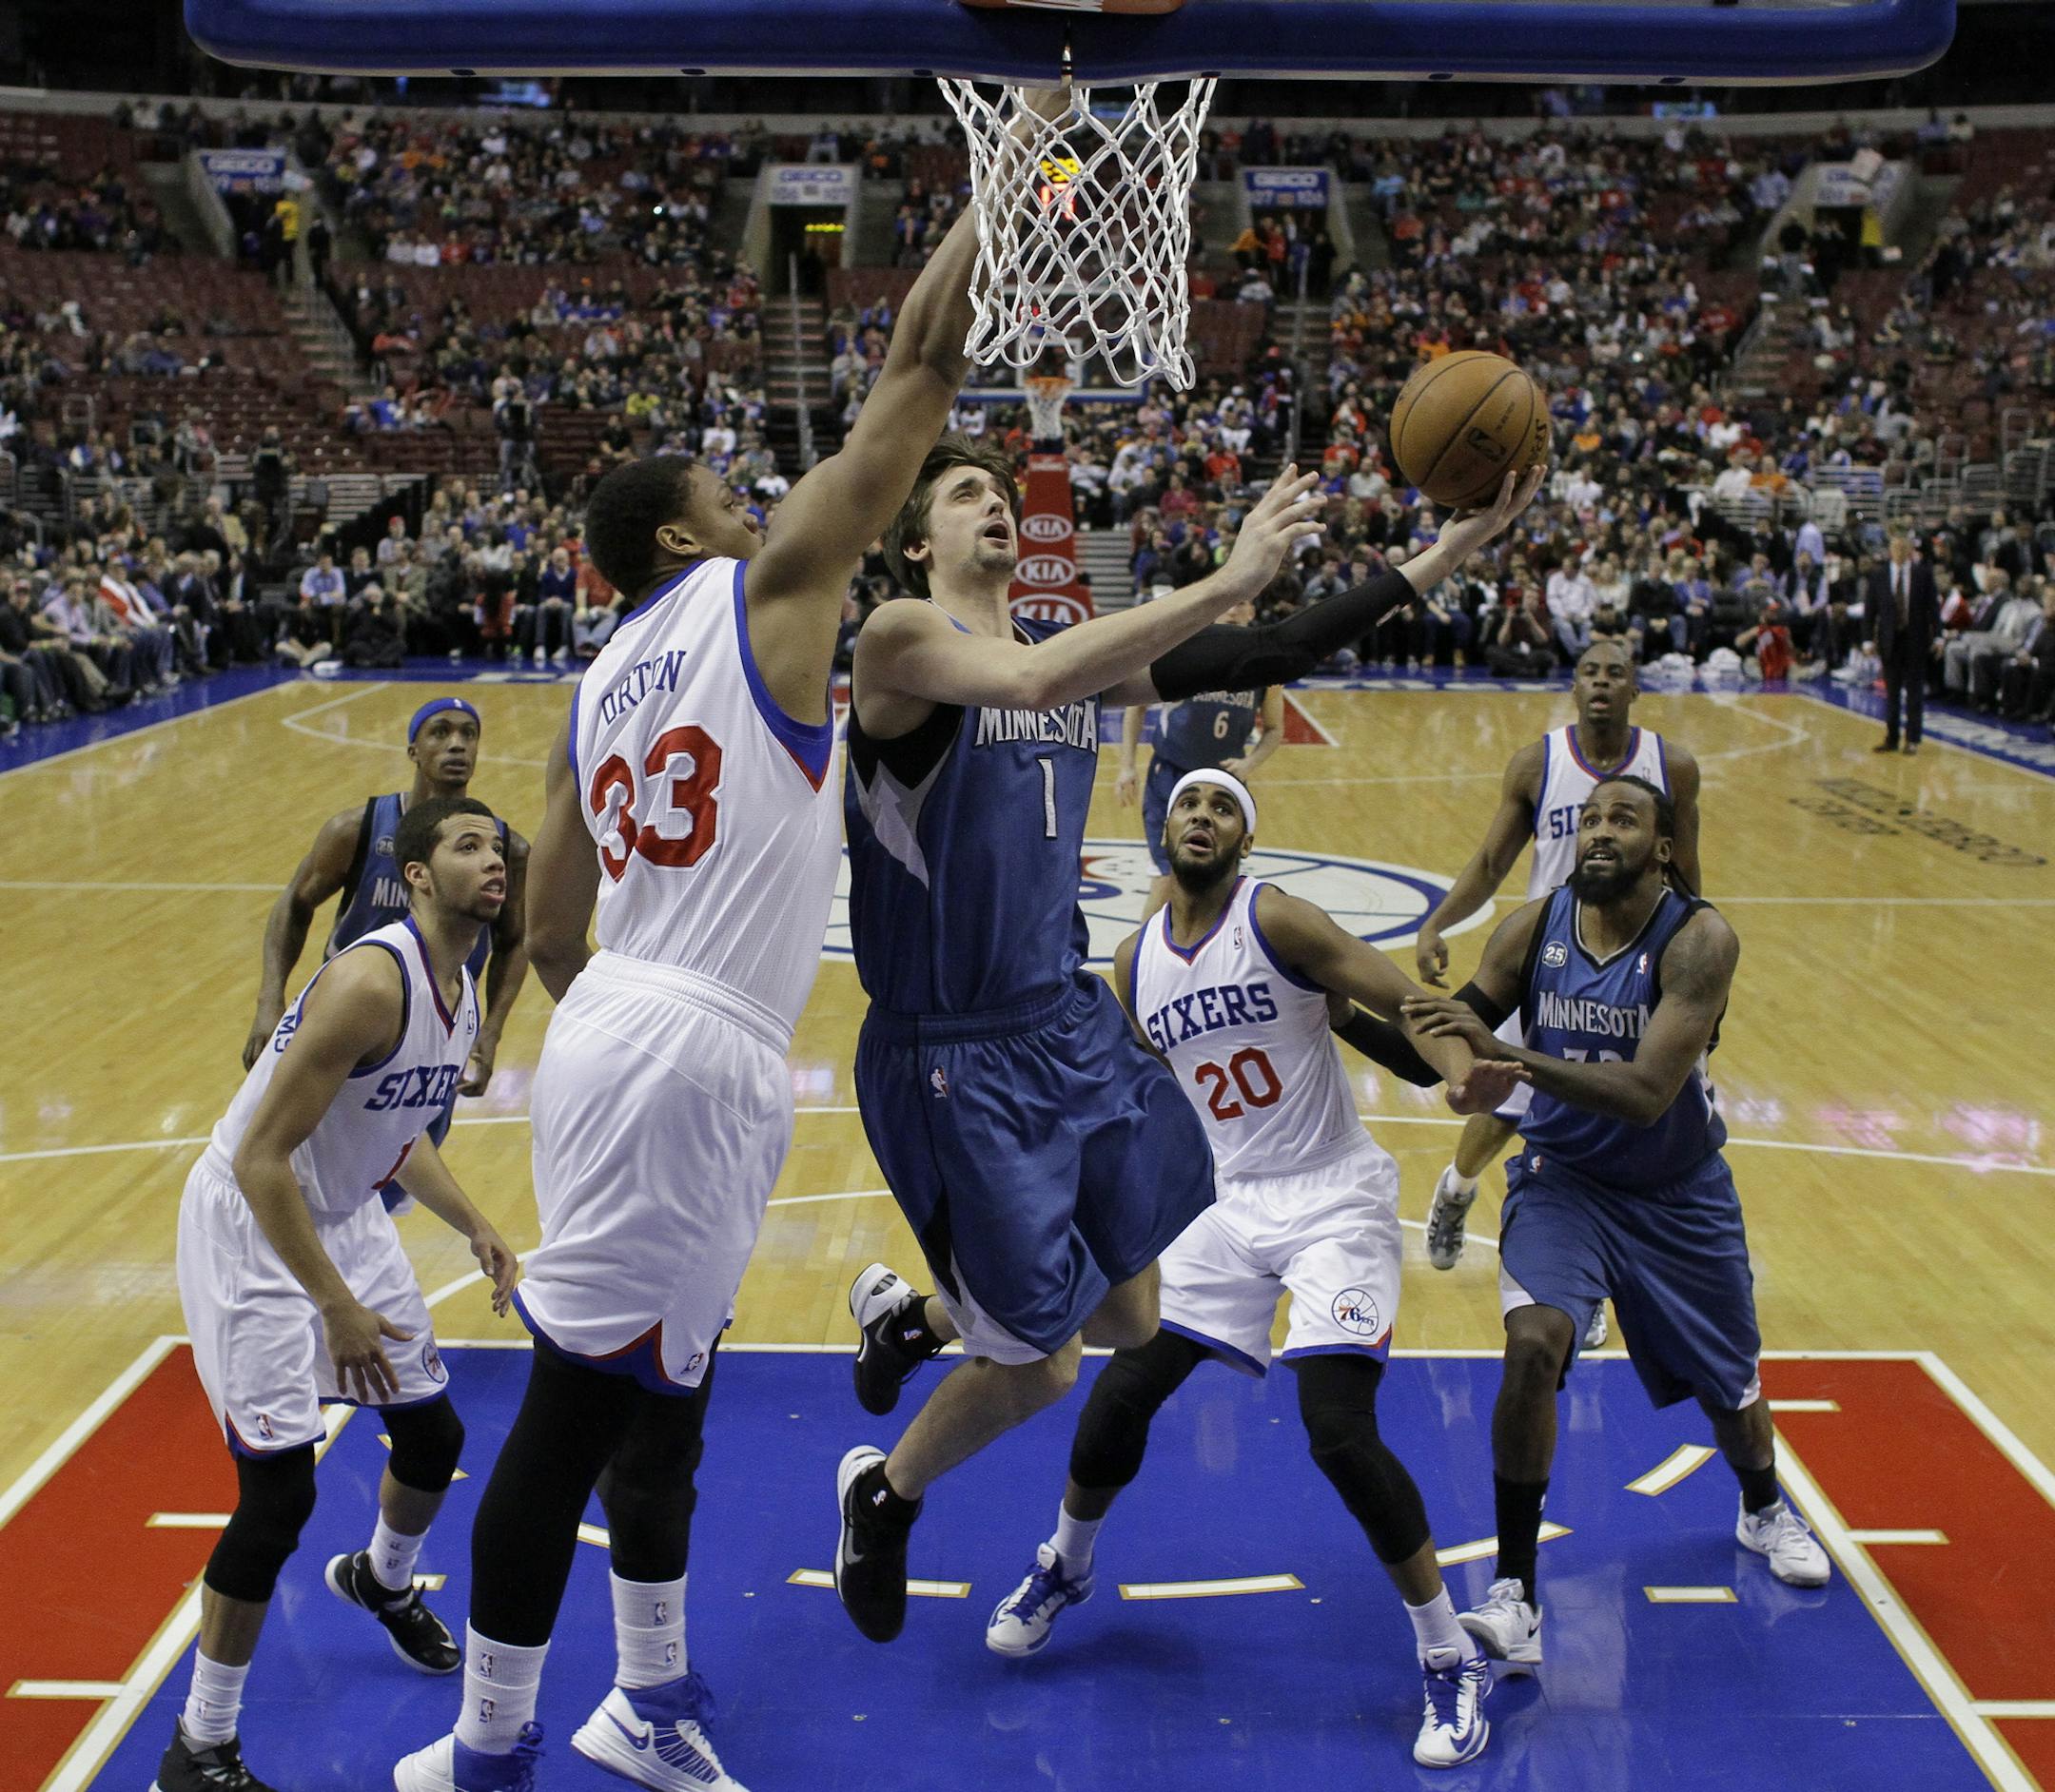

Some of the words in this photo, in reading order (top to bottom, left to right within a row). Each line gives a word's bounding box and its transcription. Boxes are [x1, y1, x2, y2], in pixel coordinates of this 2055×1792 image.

[1028, 519, 1064, 536] KIA
[1026, 562, 1067, 580] KIA
[1018, 604, 1073, 624] KIA
[601, 650, 686, 725] ORTON
[975, 699, 1098, 754] MINNESOTA
[1214, 711, 1229, 739] 6
[590, 725, 722, 883] 33
[1038, 758, 1058, 838] 1
[1544, 945, 1565, 963] 25
[1147, 983, 1279, 1055] SIXERS
[1537, 991, 1651, 1040] MINNESOTA
[1195, 1047, 1283, 1121] 20
